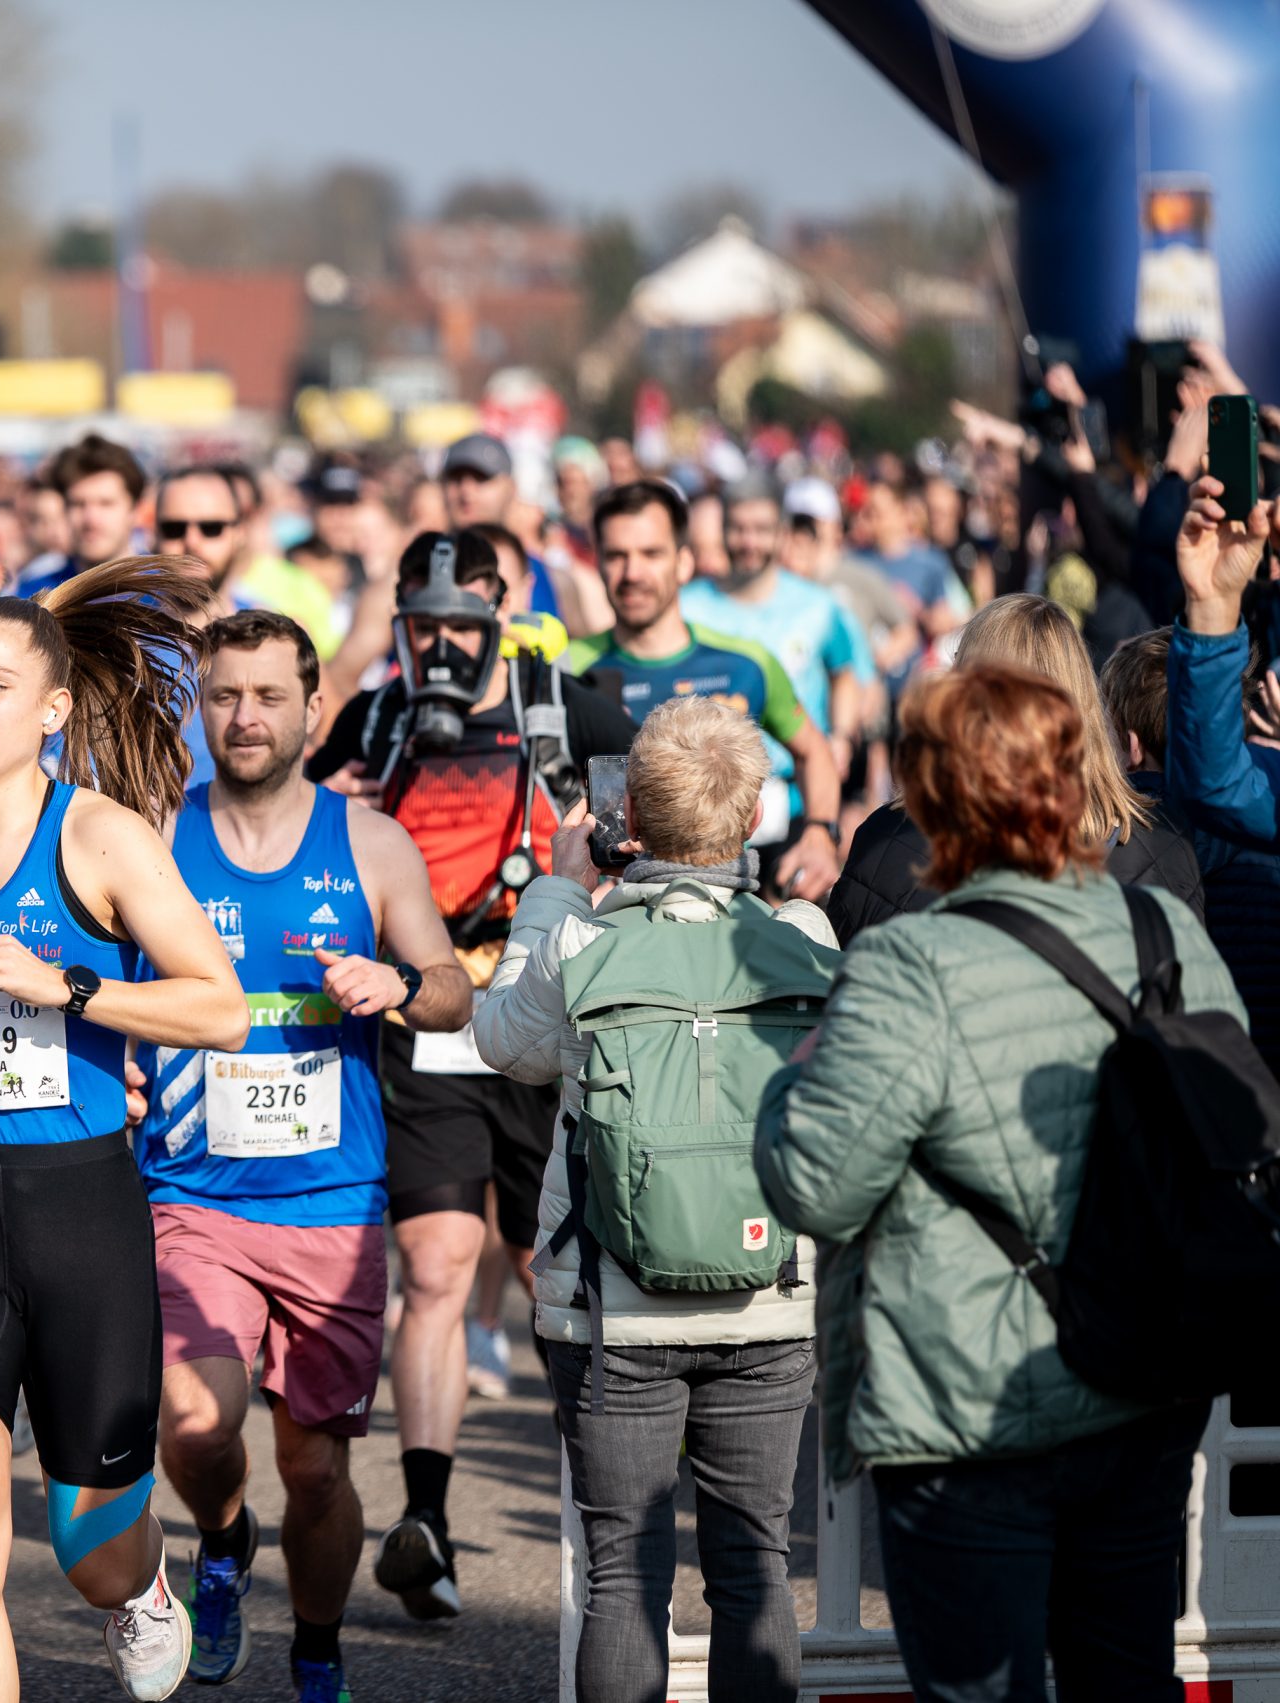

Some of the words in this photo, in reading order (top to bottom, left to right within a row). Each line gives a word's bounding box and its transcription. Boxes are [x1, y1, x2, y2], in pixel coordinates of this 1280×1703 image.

[303, 876, 323, 893] Top
[334, 878, 356, 894] Life
[17, 899, 45, 907] adidas
[31, 919, 59, 936] Life
[282, 931, 309, 948] Zapf
[37, 943, 63, 958] Hof
[10, 1000, 39, 1019] 0.0
[230, 1062, 286, 1082] Bitburger
[302, 1059, 324, 1076] 0.0
[246, 1084, 306, 1109] 2376
[255, 1112, 298, 1124] MICHAEL
